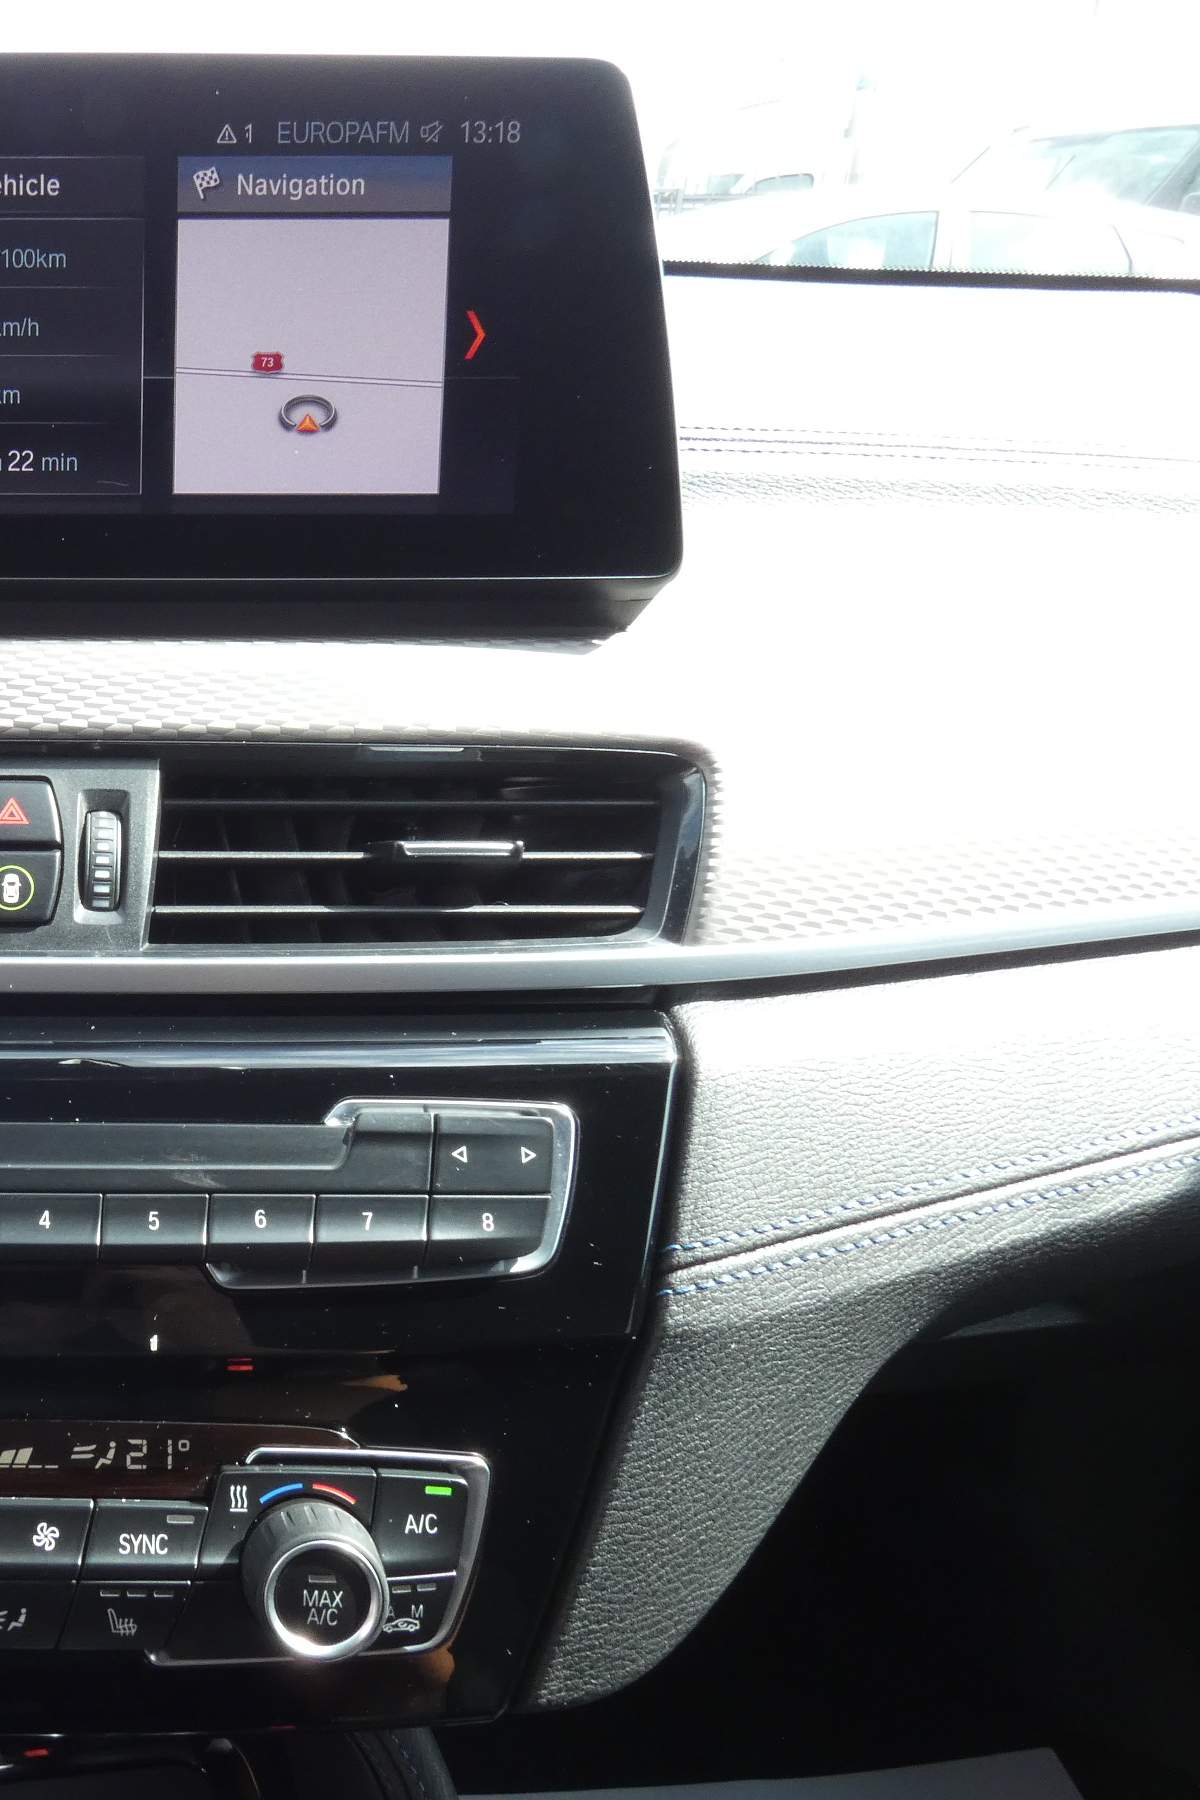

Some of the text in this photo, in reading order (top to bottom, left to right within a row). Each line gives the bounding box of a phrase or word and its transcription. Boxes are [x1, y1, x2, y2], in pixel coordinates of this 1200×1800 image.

[244, 123, 253, 143] 1
[277, 121, 409, 144] EUROPAFM
[460, 120, 521, 143] 13:18
[236, 173, 366, 200] Navigation
[261, 357, 274, 368] 73
[8, 450, 34, 471] 22
[41, 452, 78, 471] min
[38, 1210, 51, 1230] 4
[147, 1211, 160, 1231] 5
[254, 1210, 267, 1229] 6
[362, 1212, 373, 1231] 7
[482, 1213, 495, 1232] 8
[405, 1512, 438, 1535] A/C
[118, 1533, 169, 1555] SYNC
[303, 1589, 343, 1608] MAX
[307, 1608, 338, 1626] A/C
[411, 1604, 424, 1618] M
